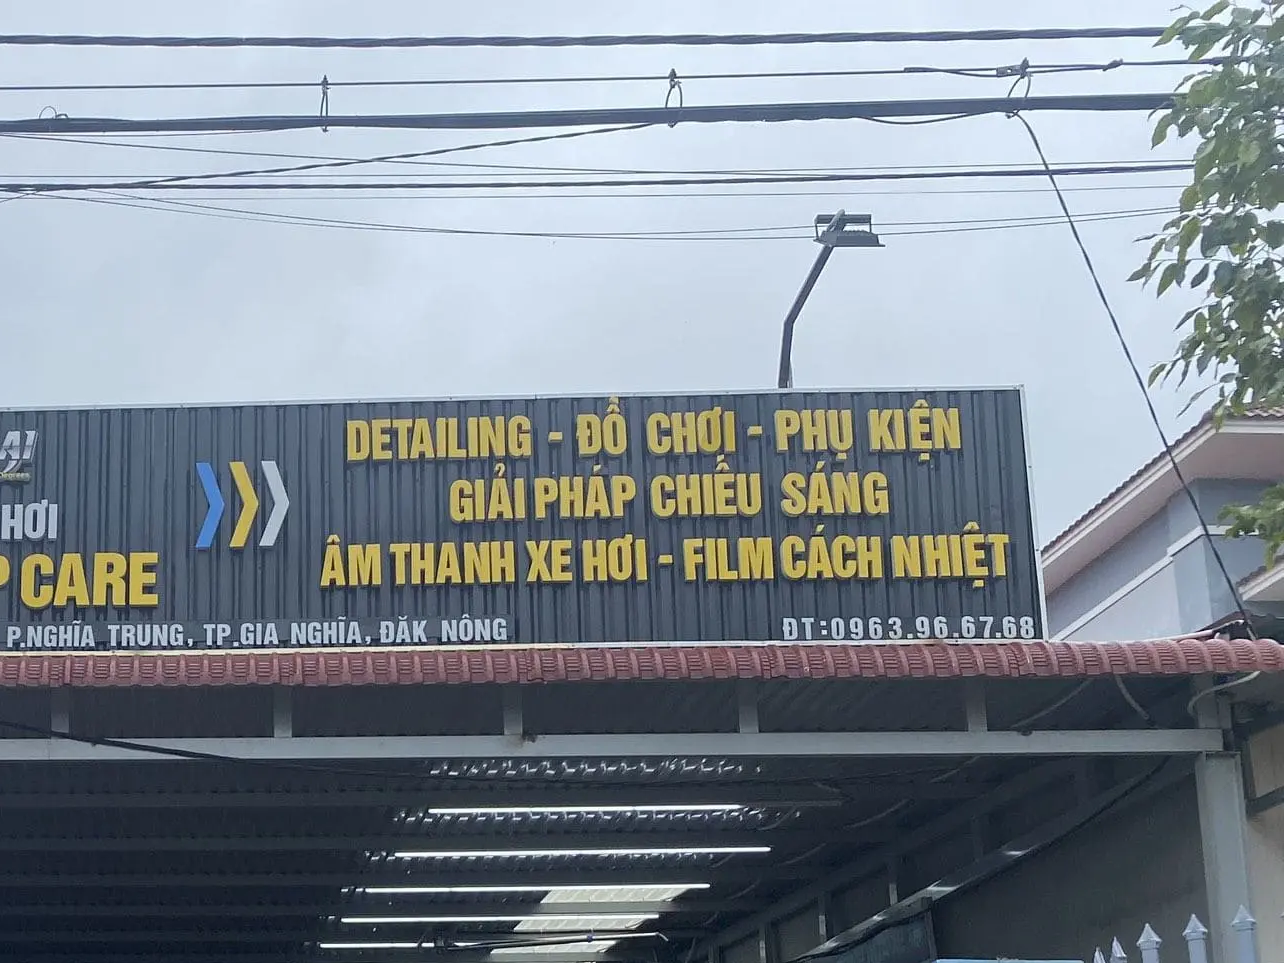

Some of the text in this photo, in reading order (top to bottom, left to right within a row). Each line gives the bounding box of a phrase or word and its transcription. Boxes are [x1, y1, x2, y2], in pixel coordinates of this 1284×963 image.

[346, 415, 532, 461] DETAILING
[576, 395, 627, 456] ĐỒ
[647, 406, 736, 454] CHƠI
[774, 409, 854, 460] PHỤ
[868, 399, 961, 461] KIỆN
[450, 454, 889, 523] GIẢI PHÁP CHIẾU SÁNG
[1, 499, 58, 540] HƠI
[20, 552, 158, 609] CARE
[320, 534, 382, 587] ÂM
[389, 541, 515, 586] THANH
[525, 539, 573, 583] XE
[582, 534, 648, 583] HƠI
[683, 536, 774, 582] FILM
[780, 524, 883, 579] CÁCH
[890, 521, 1009, 588] NHIỆT
[7, 620, 95, 649] P.NGHĨA
[107, 624, 193, 648] TRUNG,
[291, 616, 371, 645] NGHĨA,
[379, 615, 428, 643] ĐĂK
[441, 613, 508, 642] NÔNG
